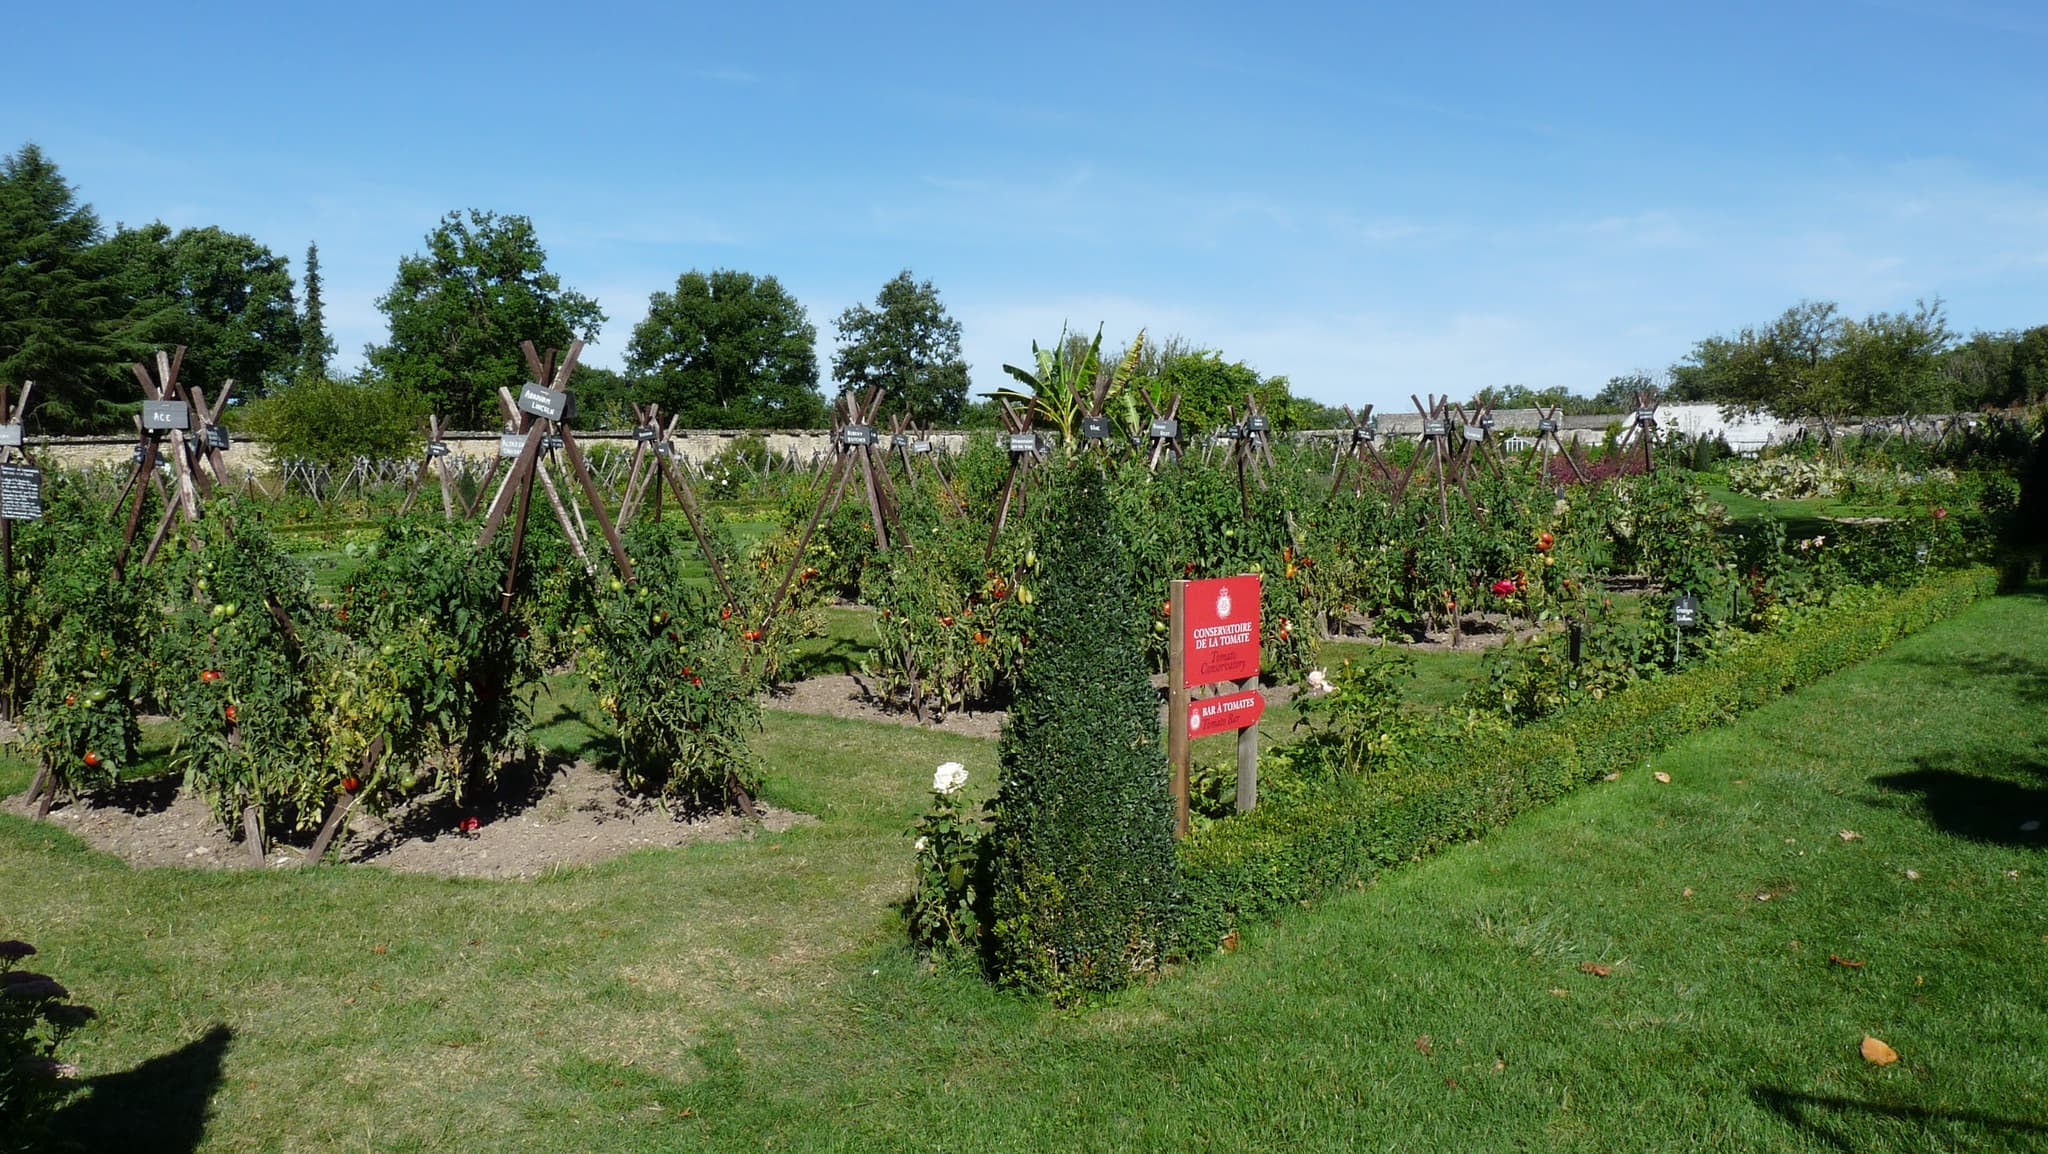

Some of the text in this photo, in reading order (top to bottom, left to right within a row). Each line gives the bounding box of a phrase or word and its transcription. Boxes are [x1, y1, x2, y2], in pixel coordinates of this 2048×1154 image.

[153, 411, 171, 422] ACE
[1193, 622, 1252, 639] CONSERVATOIRE
[1195, 632, 1250, 649] DE LA TOMATE
[1202, 697, 1255, 717] BAR À TOMATES
